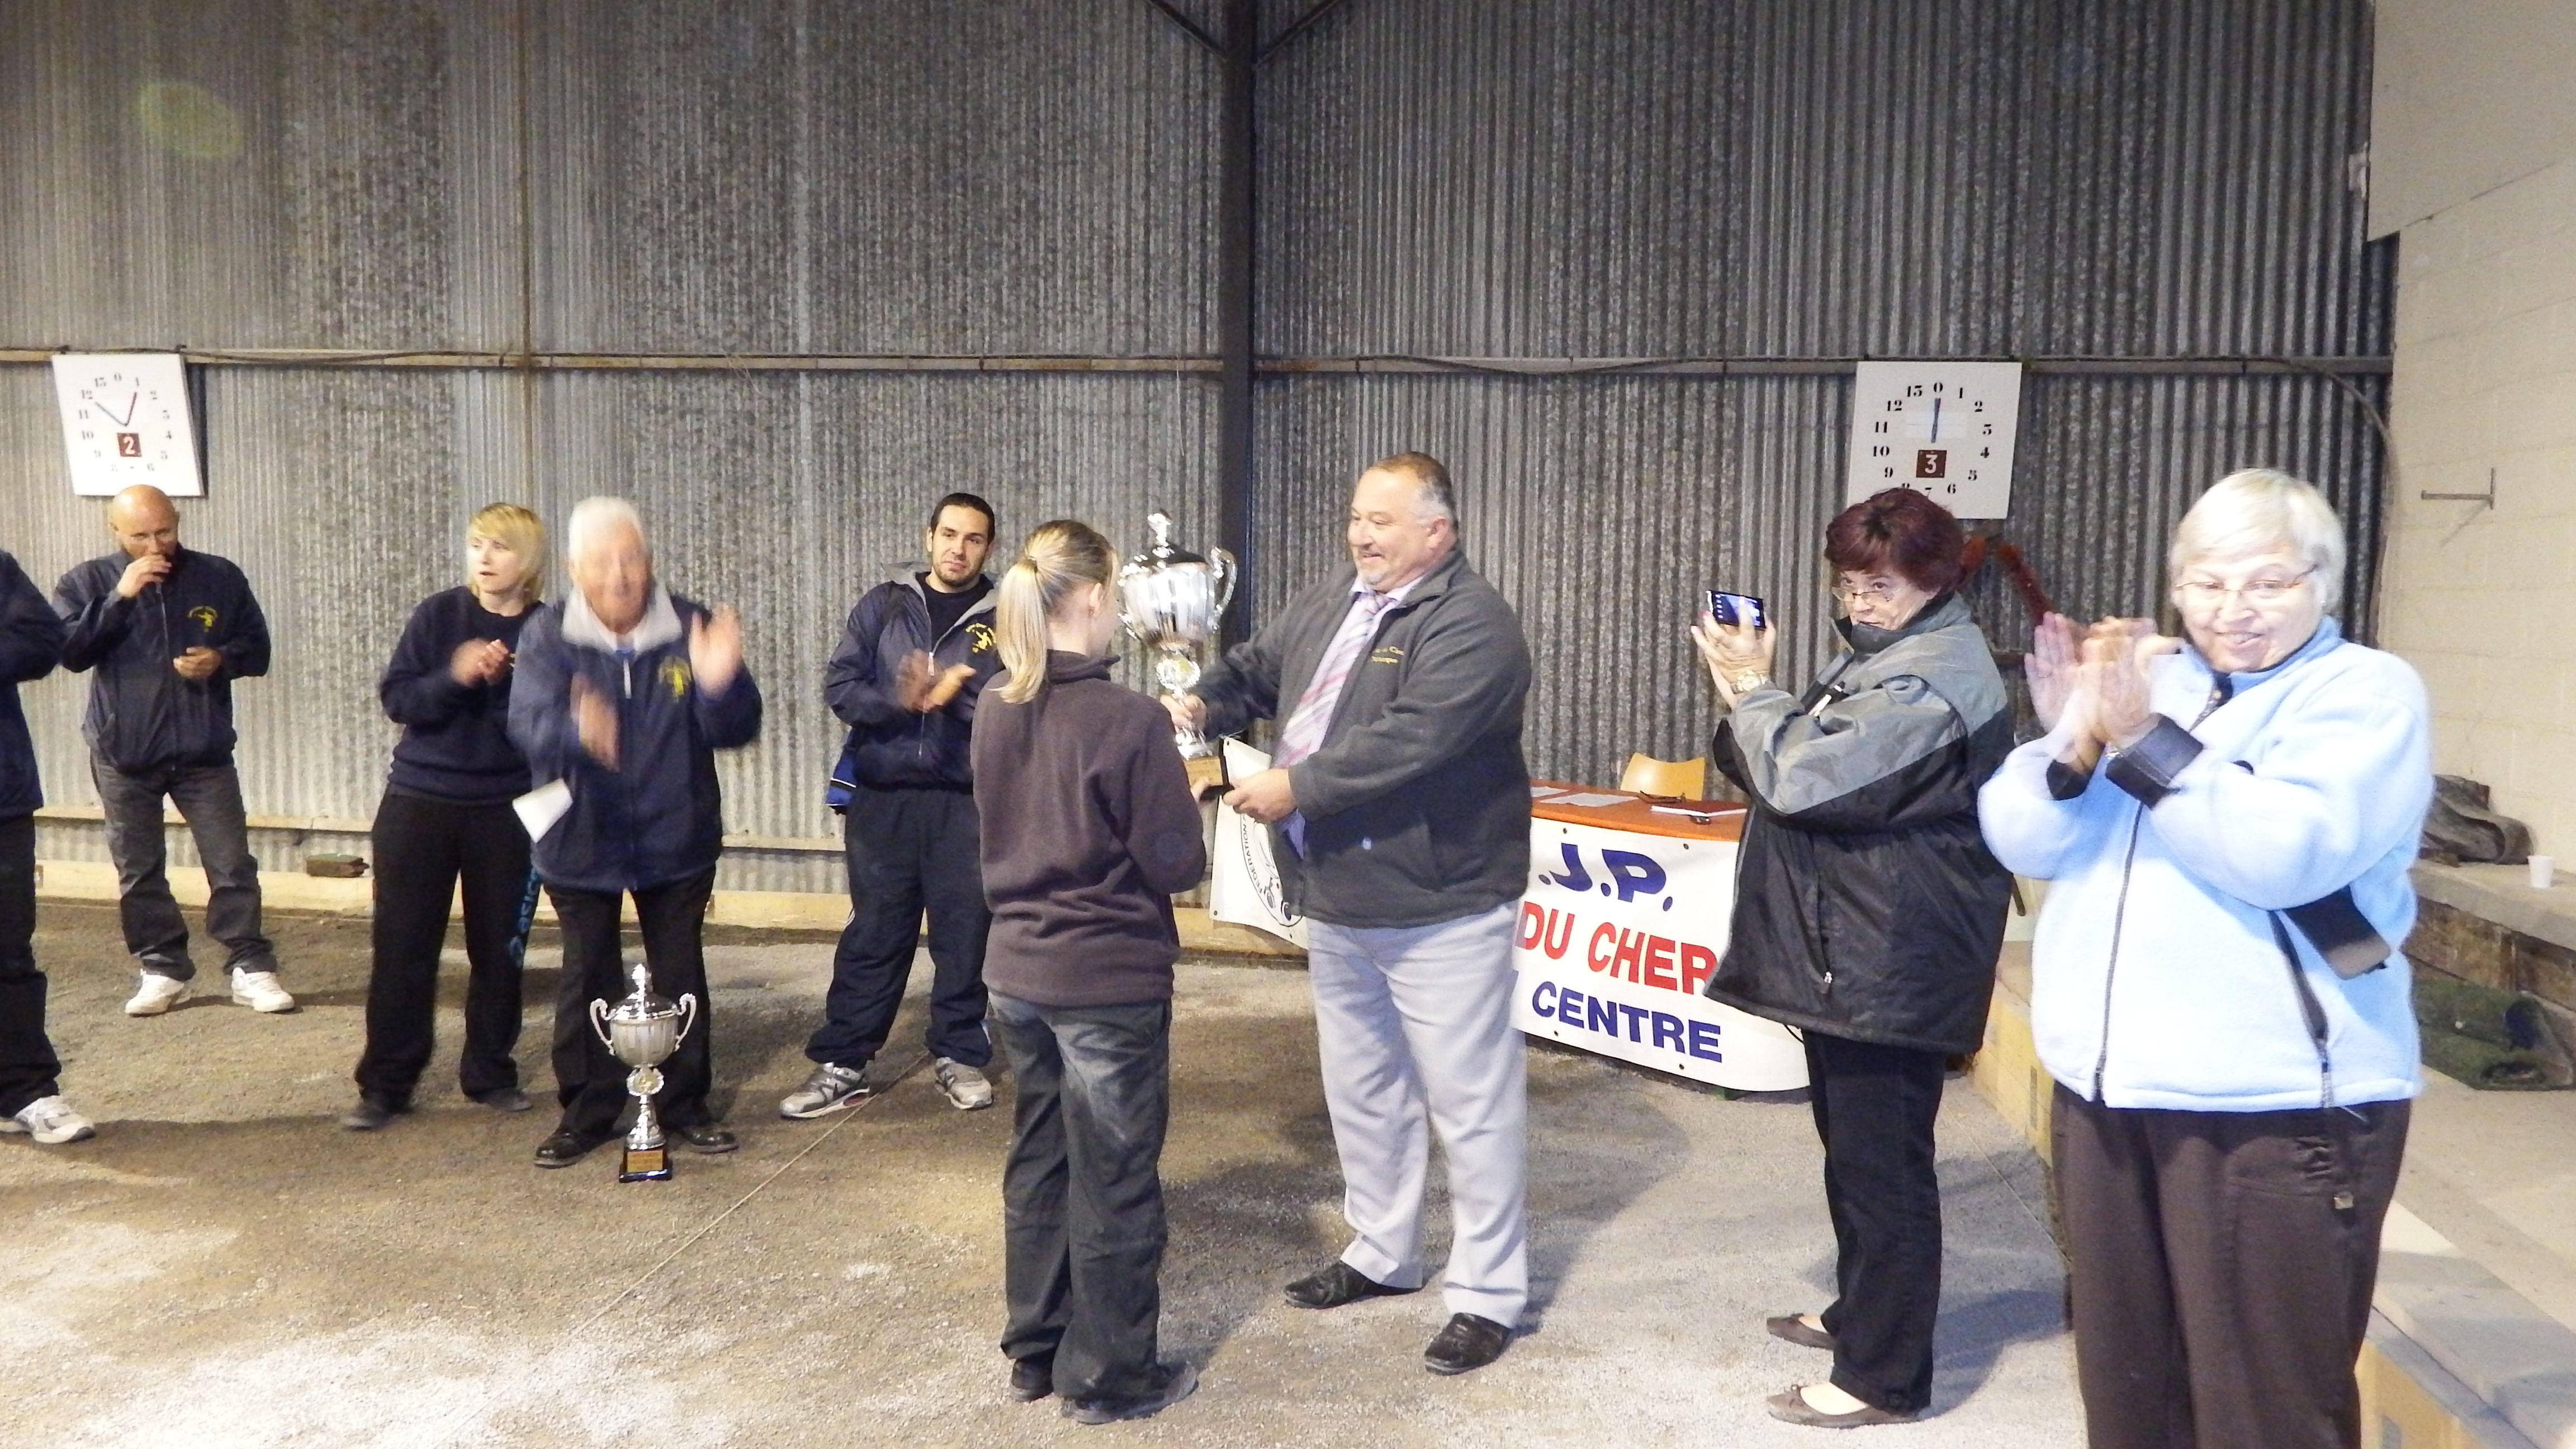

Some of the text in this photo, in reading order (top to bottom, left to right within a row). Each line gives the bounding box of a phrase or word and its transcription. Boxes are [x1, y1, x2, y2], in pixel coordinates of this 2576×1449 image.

[1933, 382, 1943, 393] 0
[1959, 387, 1963, 399] 1
[1887, 399, 1902, 412] 12
[1974, 400, 1983, 413] 2
[78, 409, 89, 420] 11
[1874, 421, 1888, 433] 11
[124, 436, 135, 455] 2
[1873, 446, 1890, 457] 10
[1980, 447, 1990, 459] 4
[1924, 453, 1938, 474] 3
[1884, 466, 1893, 478] 9
[1947, 483, 1956, 495] 6
[1515, 901, 1718, 995] DU CHER
[1532, 981, 1722, 1063] CENTRE
